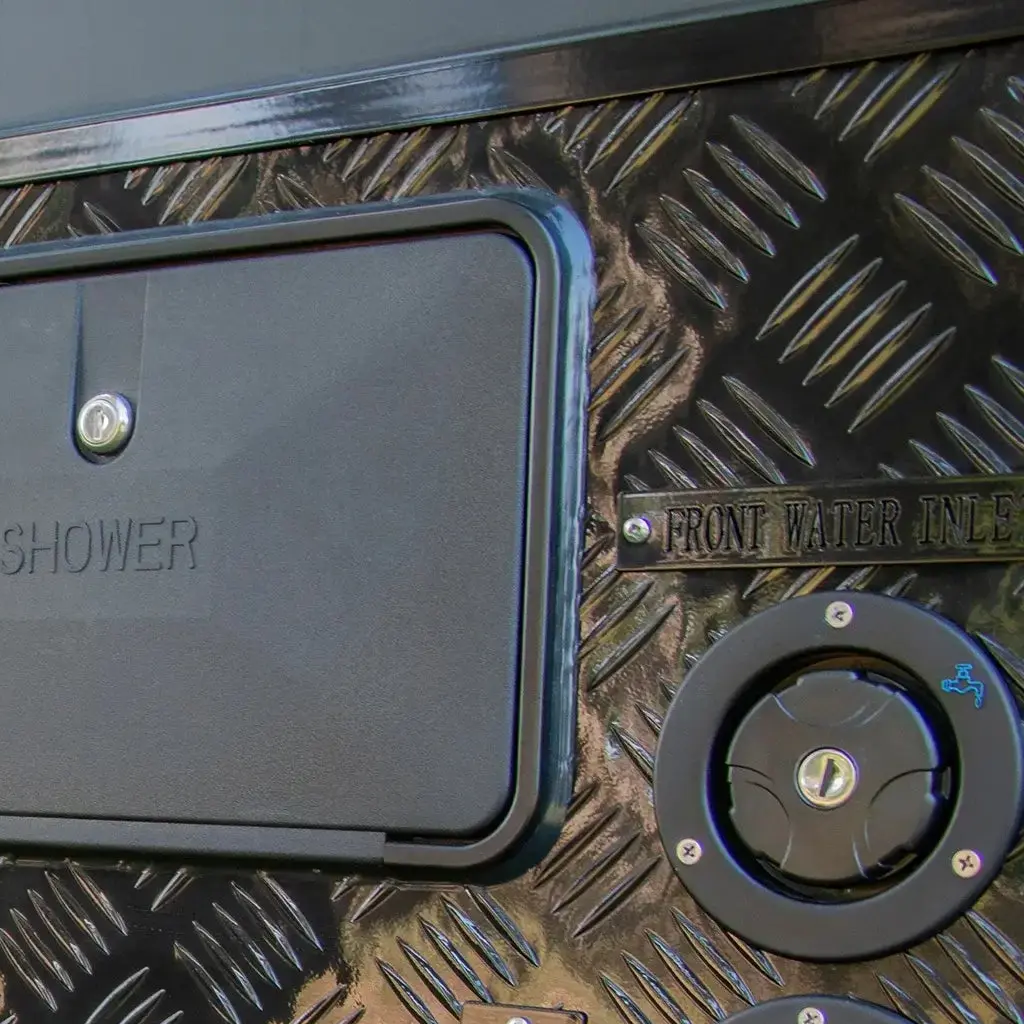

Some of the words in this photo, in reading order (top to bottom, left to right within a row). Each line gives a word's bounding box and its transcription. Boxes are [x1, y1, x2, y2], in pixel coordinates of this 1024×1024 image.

[0, 515, 199, 576] SHOWER
[666, 501, 766, 553] FRONT
[785, 498, 901, 553] WATER
[917, 493, 1024, 546] INLE
